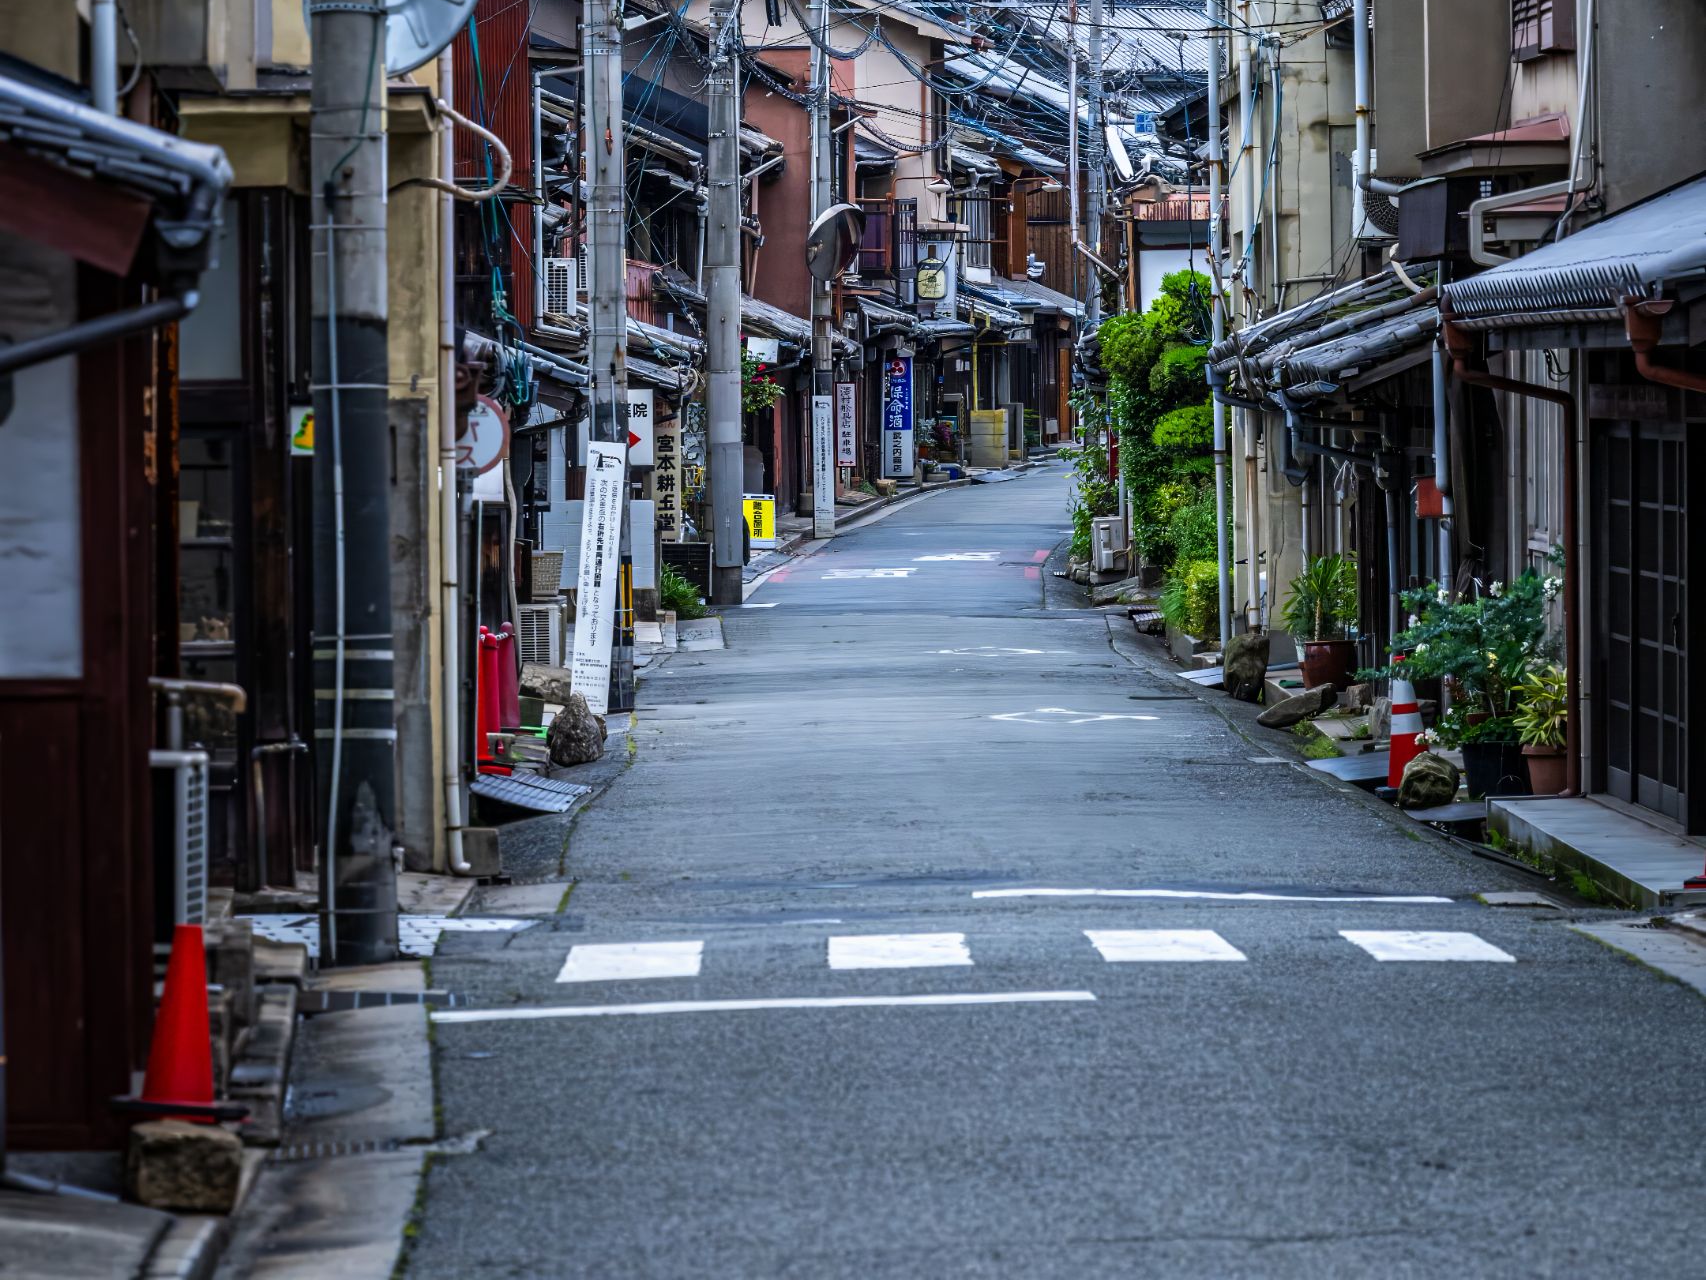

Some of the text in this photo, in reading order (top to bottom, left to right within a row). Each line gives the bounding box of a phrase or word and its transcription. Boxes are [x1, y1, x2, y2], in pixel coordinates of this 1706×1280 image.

[628, 402, 648, 418] 院
[886, 385, 905, 428] 保命酒
